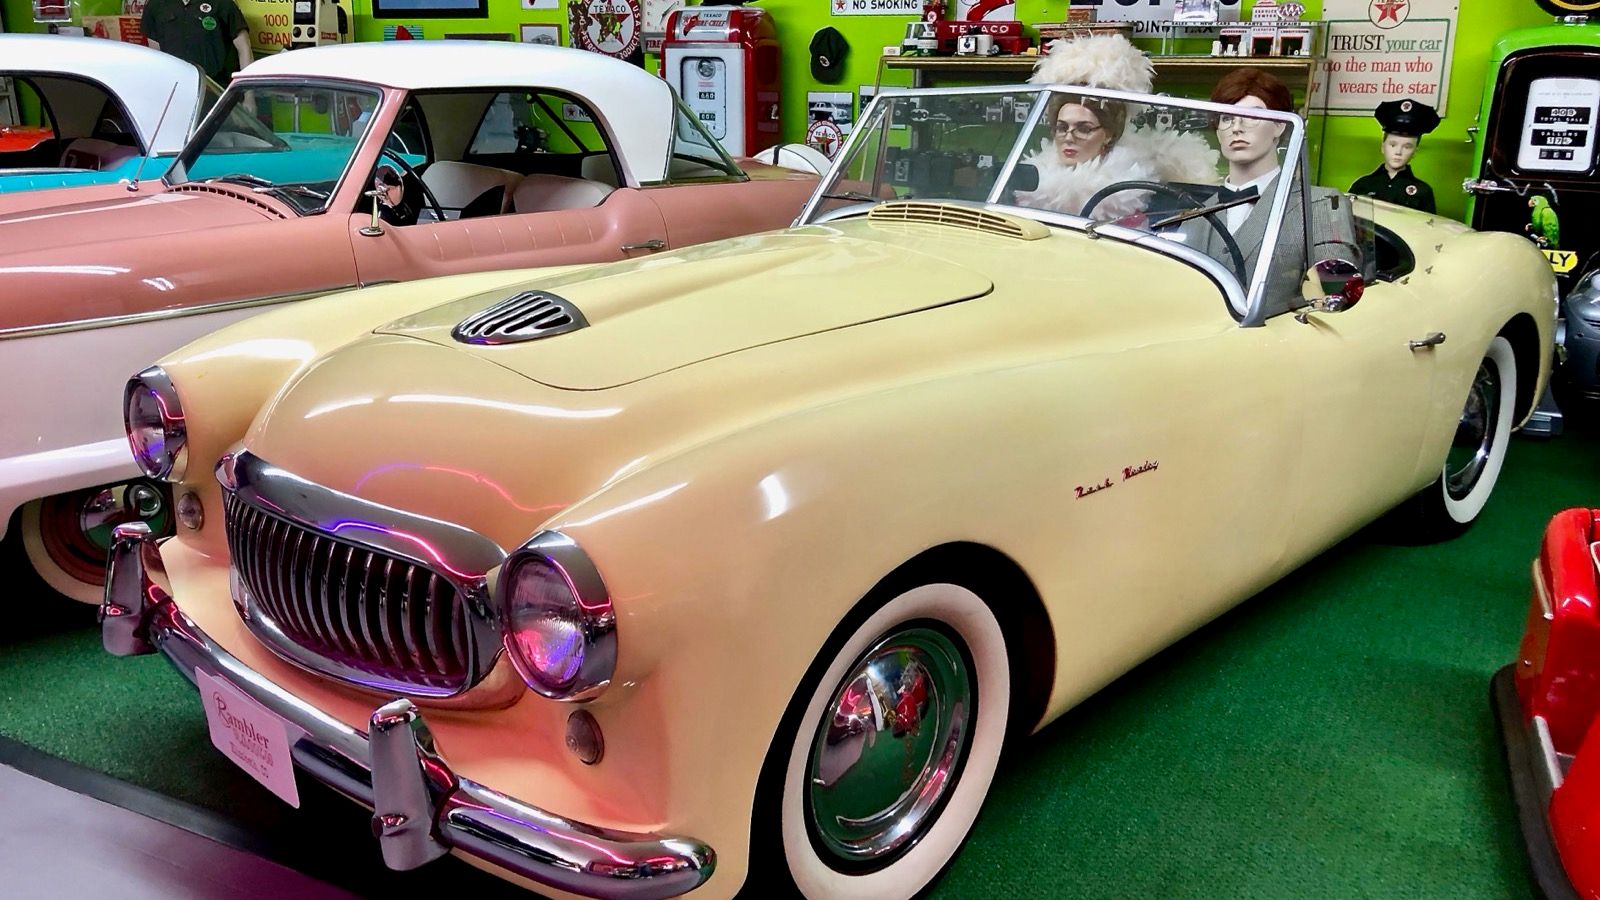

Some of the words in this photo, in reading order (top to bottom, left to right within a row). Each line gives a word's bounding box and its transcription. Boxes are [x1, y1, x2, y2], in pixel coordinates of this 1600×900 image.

[852, 0, 867, 9] NO
[871, 0, 918, 9] SMOKING
[264, 14, 289, 27] 1000
[1331, 35, 1384, 51] TRUST
[1385, 39, 1417, 54] your
[1420, 39, 1443, 50] car
[1345, 56, 1366, 72] the
[1371, 61, 1400, 73] man
[1405, 56, 1433, 73] who
[1339, 82, 1378, 93] wears
[1382, 78, 1403, 94] the
[1407, 82, 1437, 95] star
[213, 691, 270, 749] Rambler
